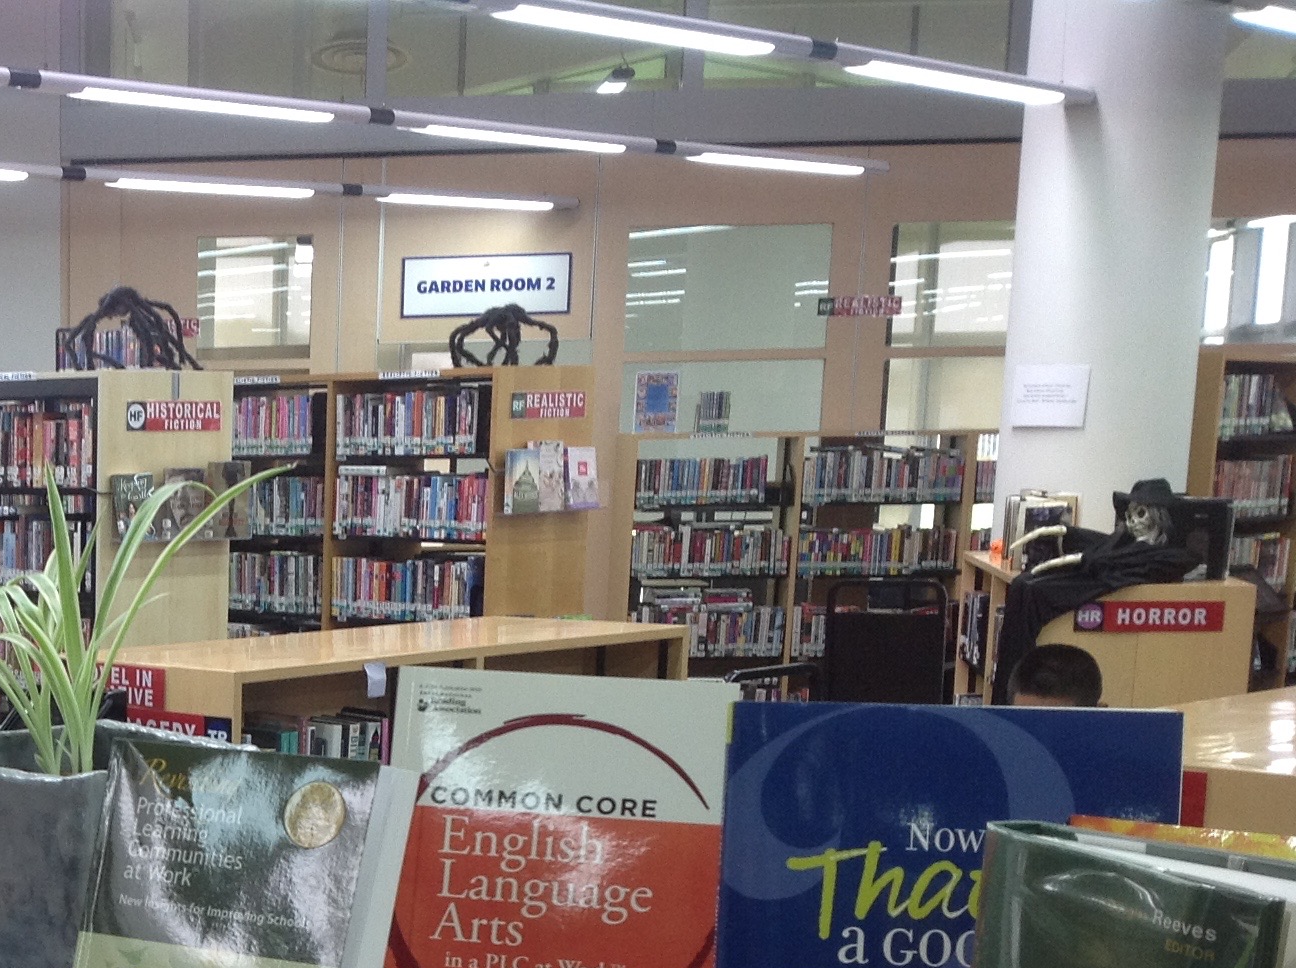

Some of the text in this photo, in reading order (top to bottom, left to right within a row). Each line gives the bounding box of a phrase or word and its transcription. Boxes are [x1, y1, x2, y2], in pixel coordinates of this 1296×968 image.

[417, 276, 556, 295] GARDEN ROOM 2
[130, 402, 220, 422] HF HISTORICAL
[513, 393, 584, 412] RF REALISTIC
[540, 408, 570, 418] FICTION
[164, 419, 202, 430] FICTION
[1077, 608, 1207, 625] HR HORROR
[136, 669, 151, 687] IN
[136, 796, 243, 825] Professional
[430, 785, 658, 818] COMMON CORE
[133, 822, 208, 849] Learning
[438, 813, 604, 871] English
[127, 838, 243, 871] Communities
[123, 864, 193, 887] at Work
[437, 858, 653, 924] Language
[785, 839, 982, 941] Tha
[119, 893, 142, 907] New
[189, 901, 204, 914] for
[207, 906, 264, 926] Improving
[429, 903, 523, 946] Arts
[1152, 910, 1217, 941] Reeves
[836, 926, 976, 968] a GOO
[1165, 939, 1216, 960] EDITOR
